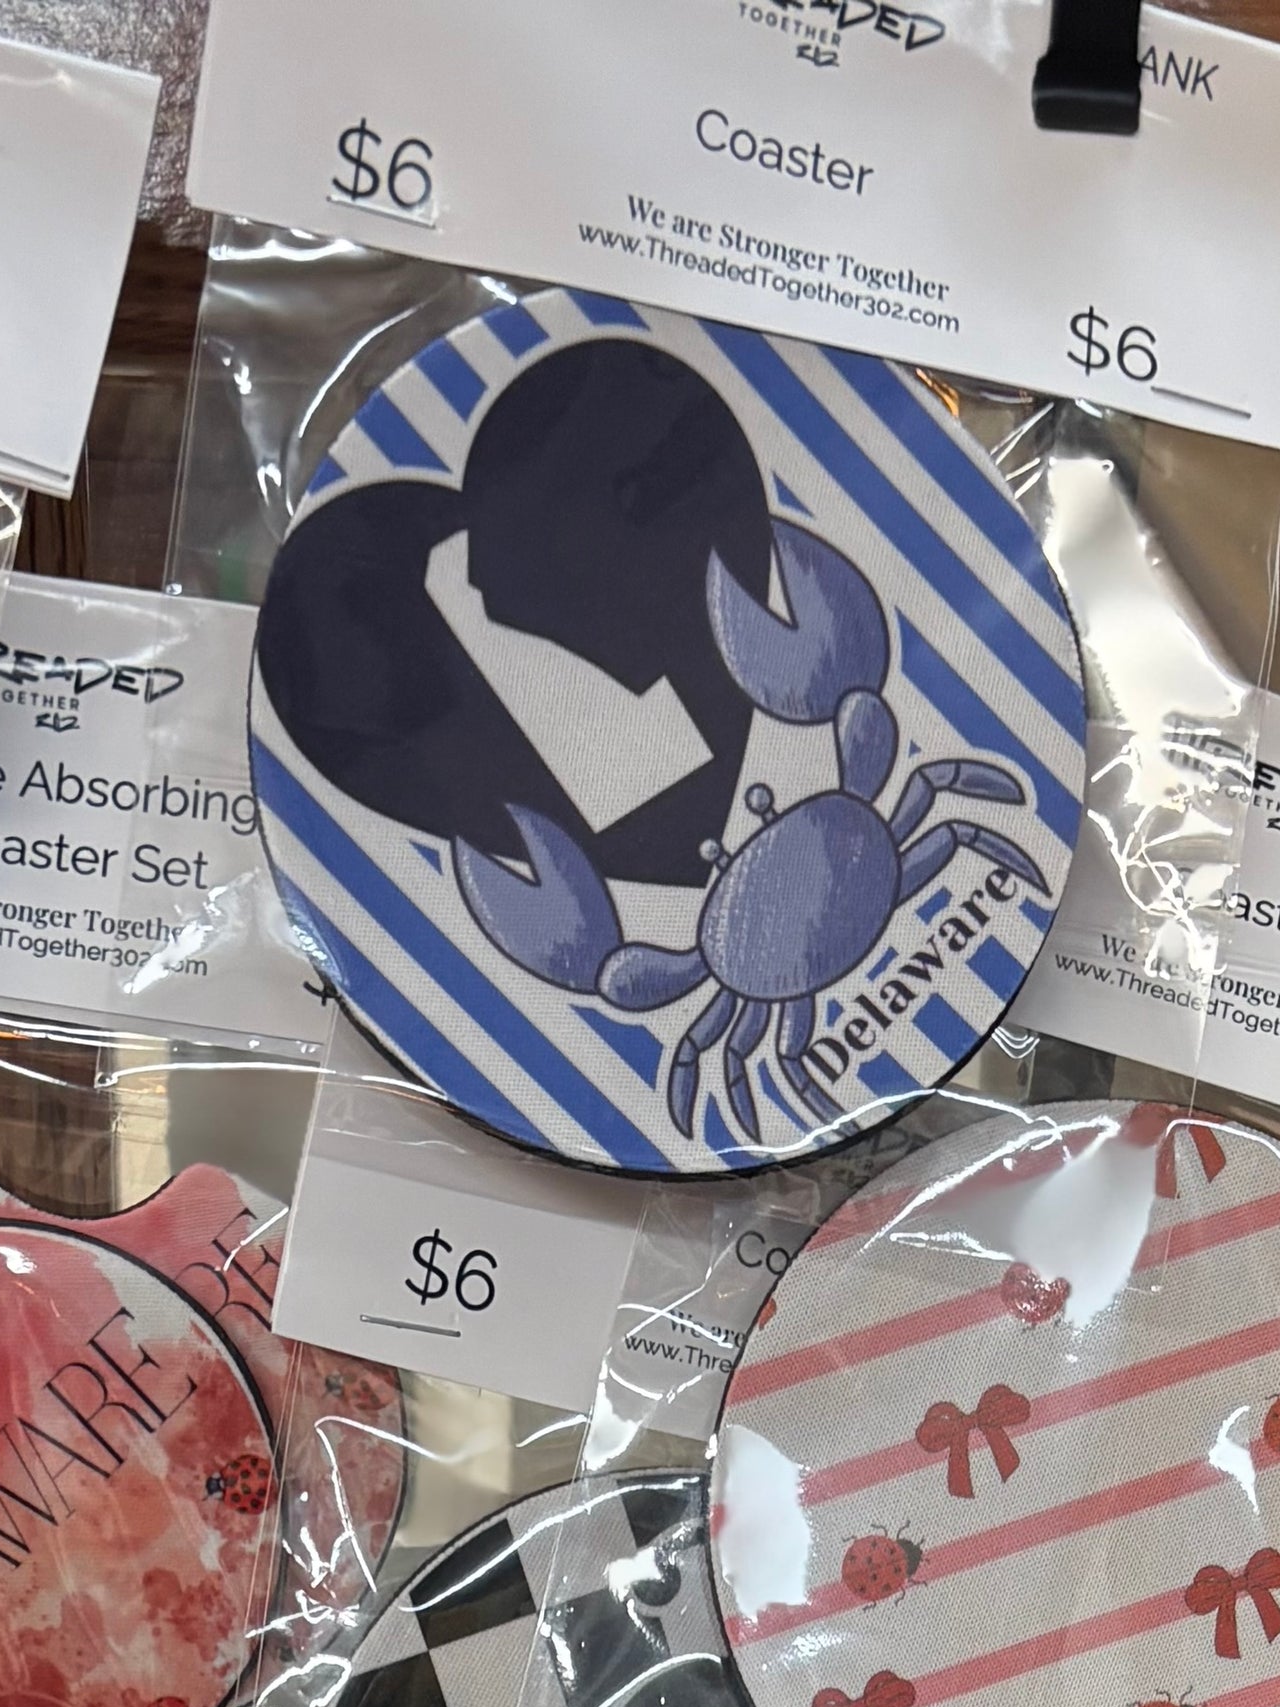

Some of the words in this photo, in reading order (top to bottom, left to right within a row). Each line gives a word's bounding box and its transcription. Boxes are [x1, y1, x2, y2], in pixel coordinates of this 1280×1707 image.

[738, 3, 842, 48] TOGETHER
[1140, 45, 1221, 102] ANK
[331, 117, 434, 210] $6
[696, 108, 874, 196] Coaster
[578, 222, 961, 334] www.ThreadedTogether302.com
[627, 194, 666, 229] We
[671, 214, 713, 243] are
[719, 221, 831, 273] Stronger
[835, 252, 950, 302] Together
[1067, 305, 1159, 383] $6
[19, 760, 259, 837] Absorbing
[131, 843, 208, 890] Set
[801, 867, 1018, 1085] Delaware
[1102, 934, 1137, 963] We
[404, 1228, 498, 1311] $6
